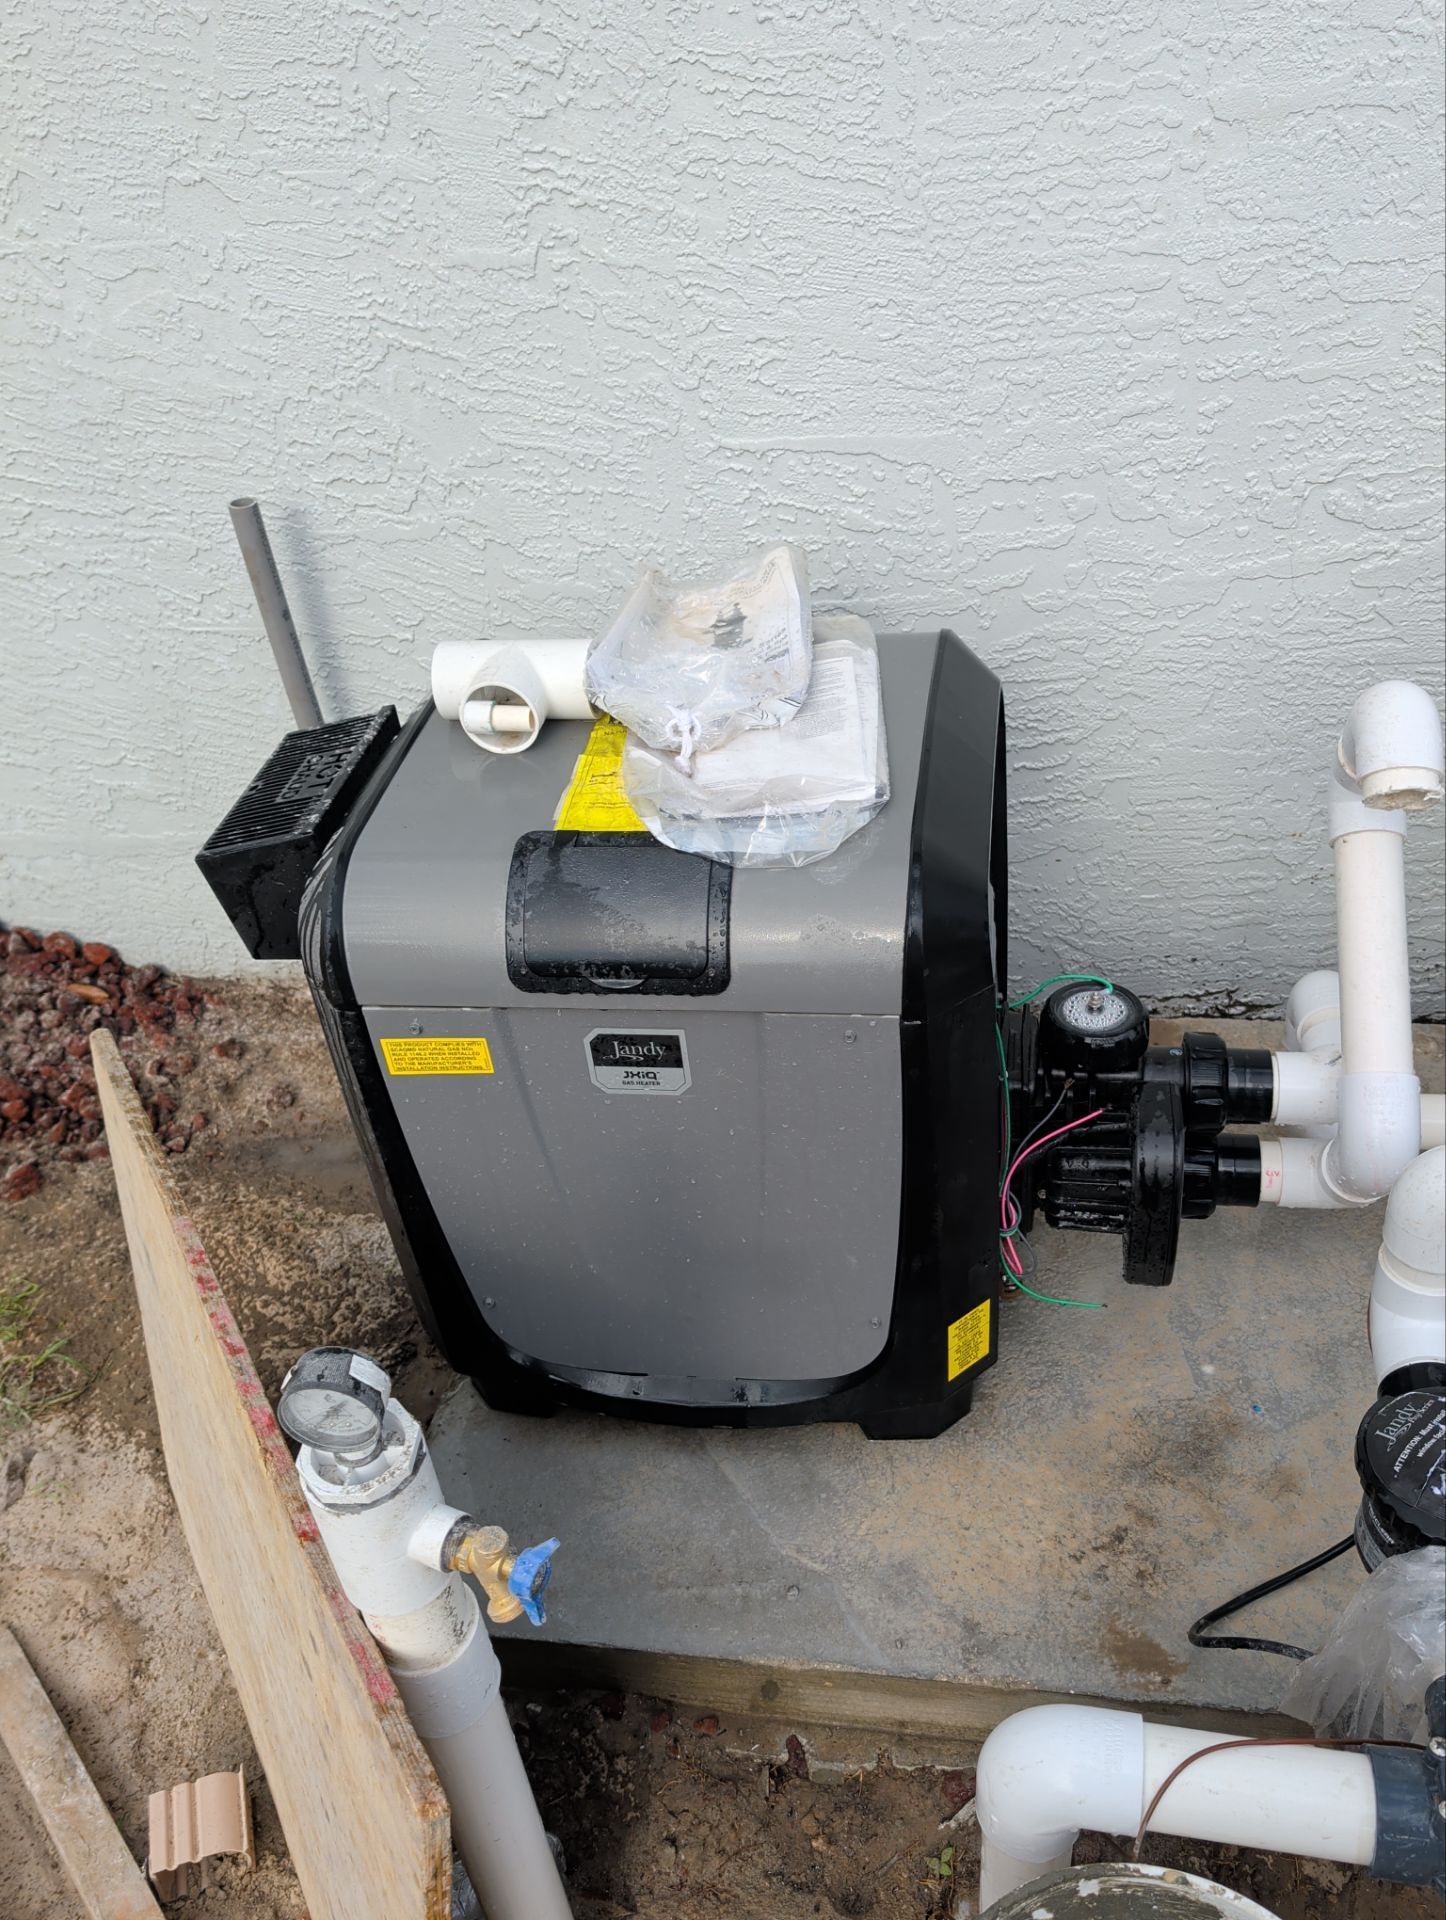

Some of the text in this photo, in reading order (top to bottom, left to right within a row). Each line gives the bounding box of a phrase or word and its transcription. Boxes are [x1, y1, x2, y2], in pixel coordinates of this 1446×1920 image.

[307, 750, 353, 789] HOT
[606, 1041, 667, 1061] Jandy
[1374, 1402, 1417, 1450] Jandy
[1393, 1435, 1422, 1473] ATTENTION:
